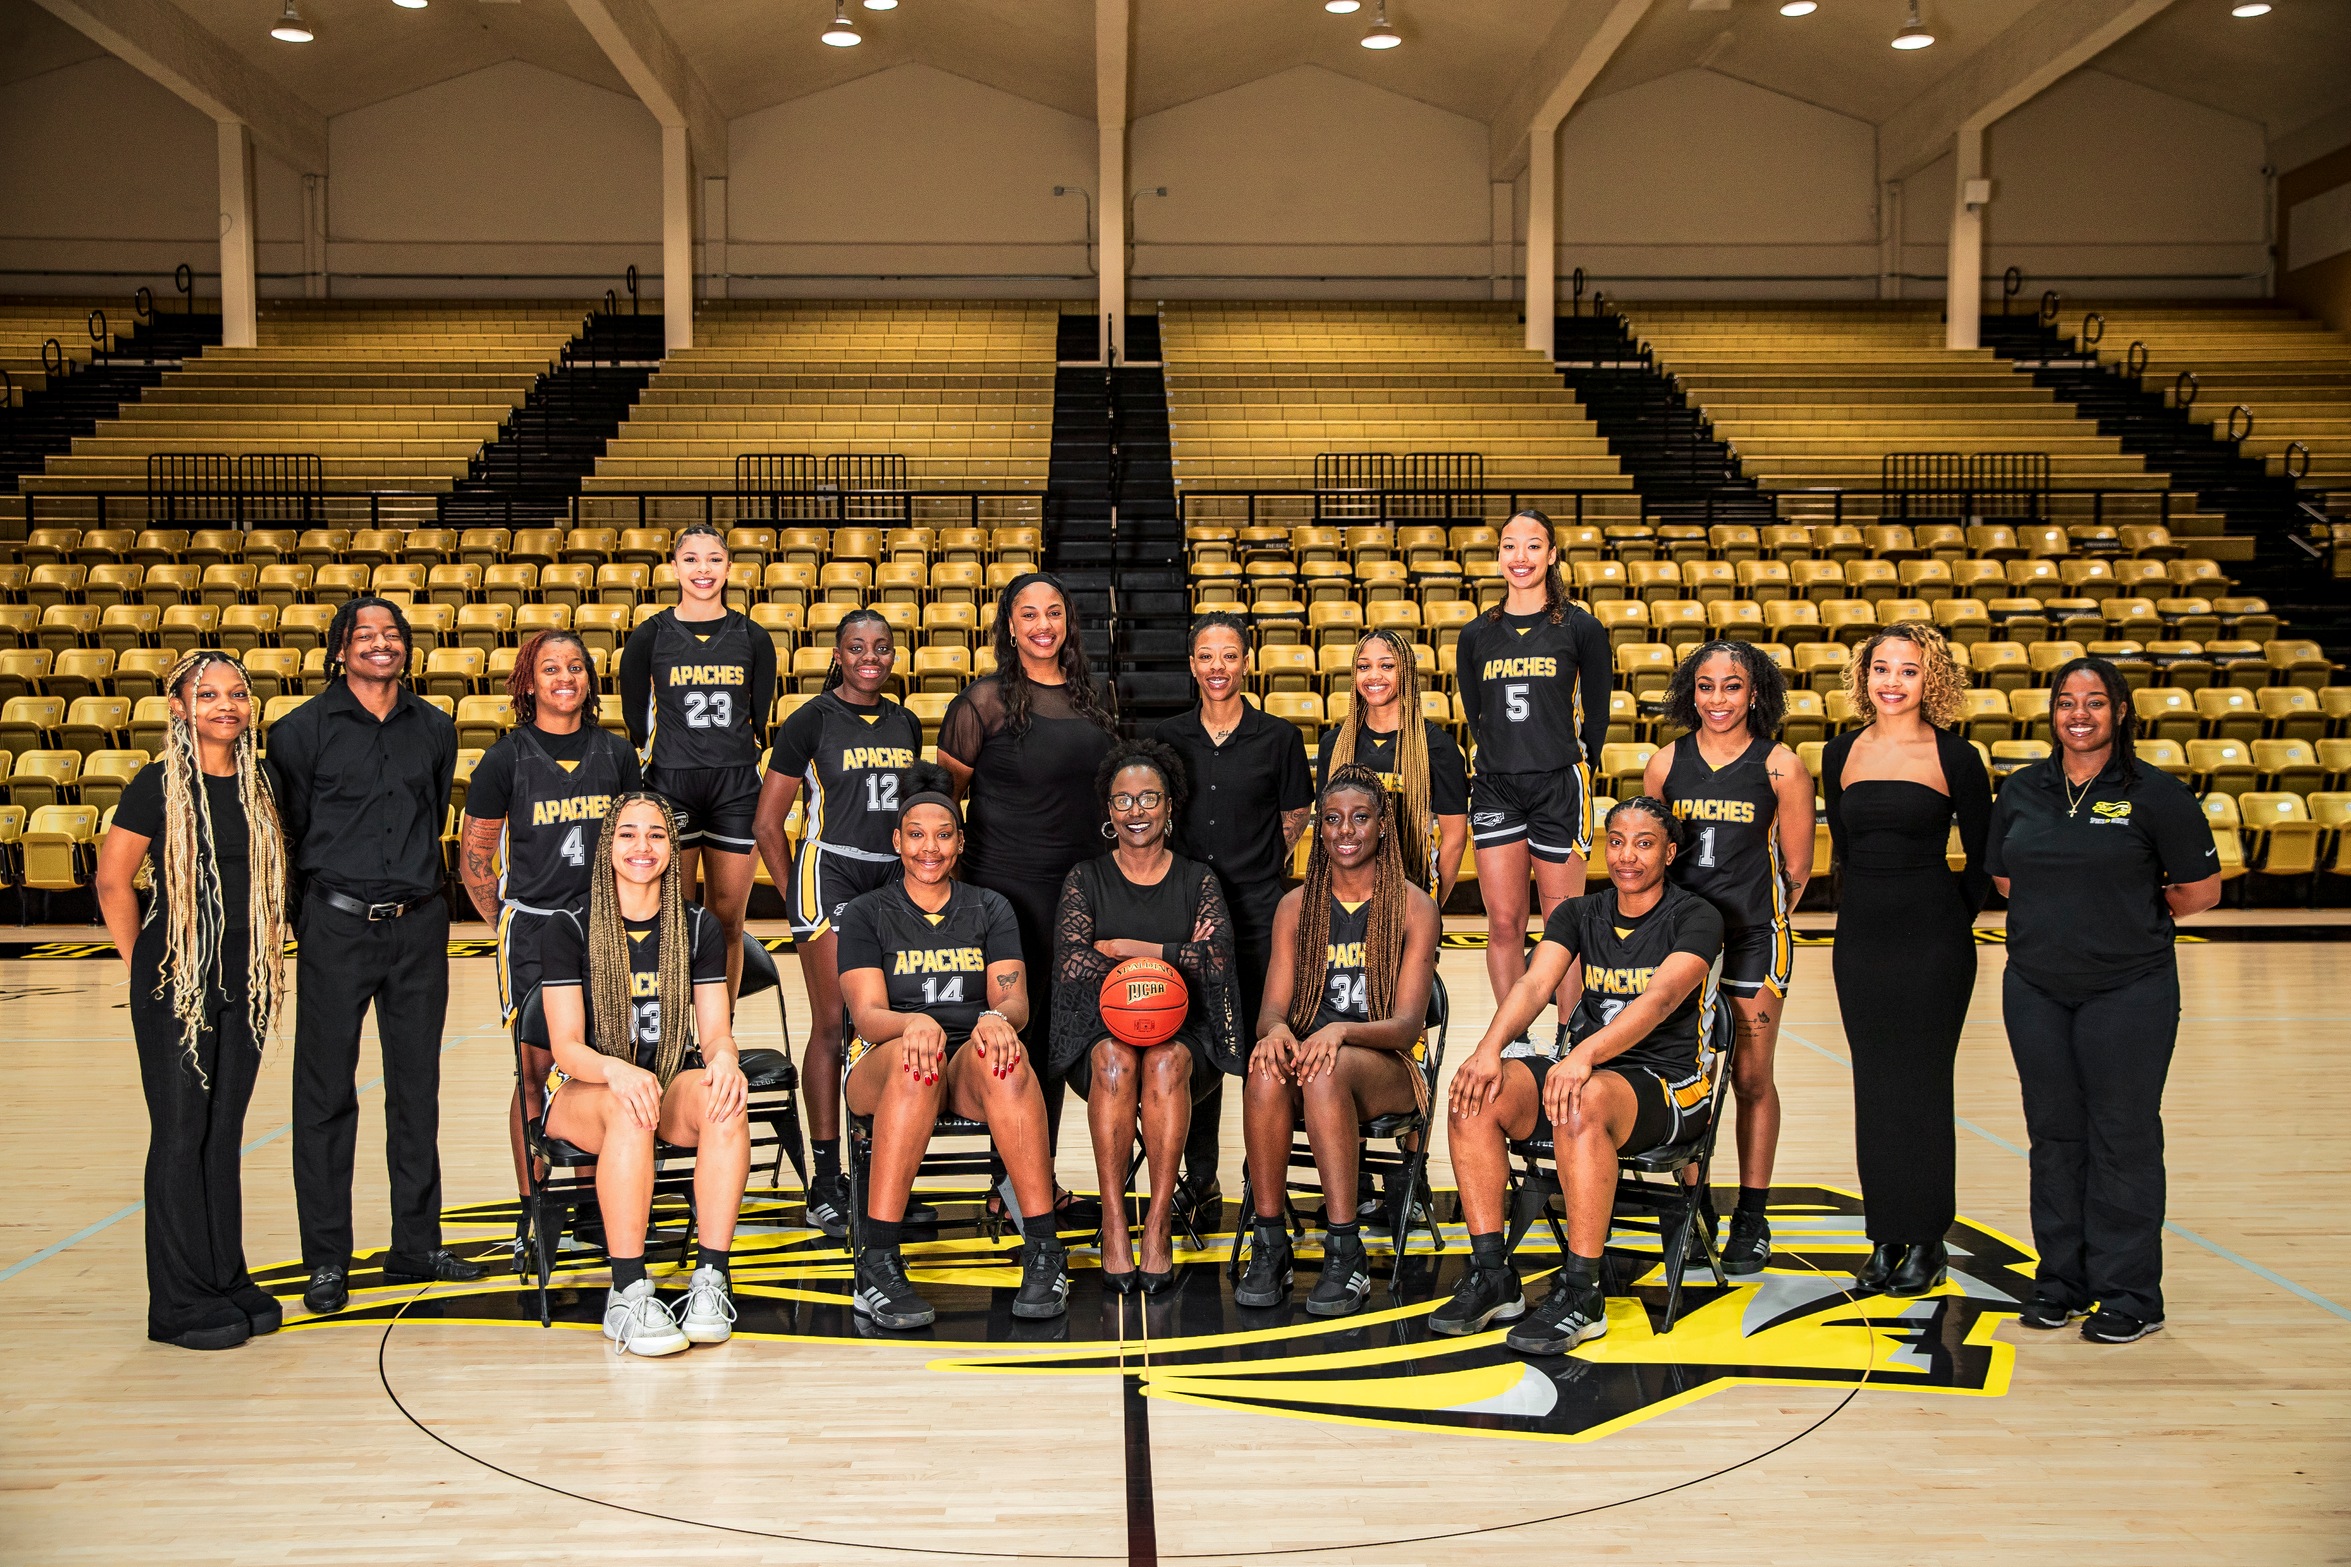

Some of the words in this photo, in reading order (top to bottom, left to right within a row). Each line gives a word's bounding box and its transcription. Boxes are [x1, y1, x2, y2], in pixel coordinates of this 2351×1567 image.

[669, 665, 745, 687] APACHES
[1482, 656, 1557, 682] APACHES
[684, 691, 733, 728] 23
[1505, 683, 1530, 722] 5
[842, 747, 914, 772] APACHES
[866, 773, 899, 812] 12
[532, 795, 611, 826] APACHES
[1672, 798, 1755, 823] APACHES
[561, 825, 585, 866] 4
[1698, 827, 1716, 867] 1
[894, 947, 985, 976] APACHES
[1327, 942, 1366, 969] PACH
[1116, 962, 1175, 980] SPALDING
[1585, 963, 1659, 994] APACHE
[921, 975, 964, 1004] 14
[1127, 981, 1166, 1002] NJCAA
[1330, 973, 1369, 1013] 34
[1600, 998, 1633, 1026] 2
